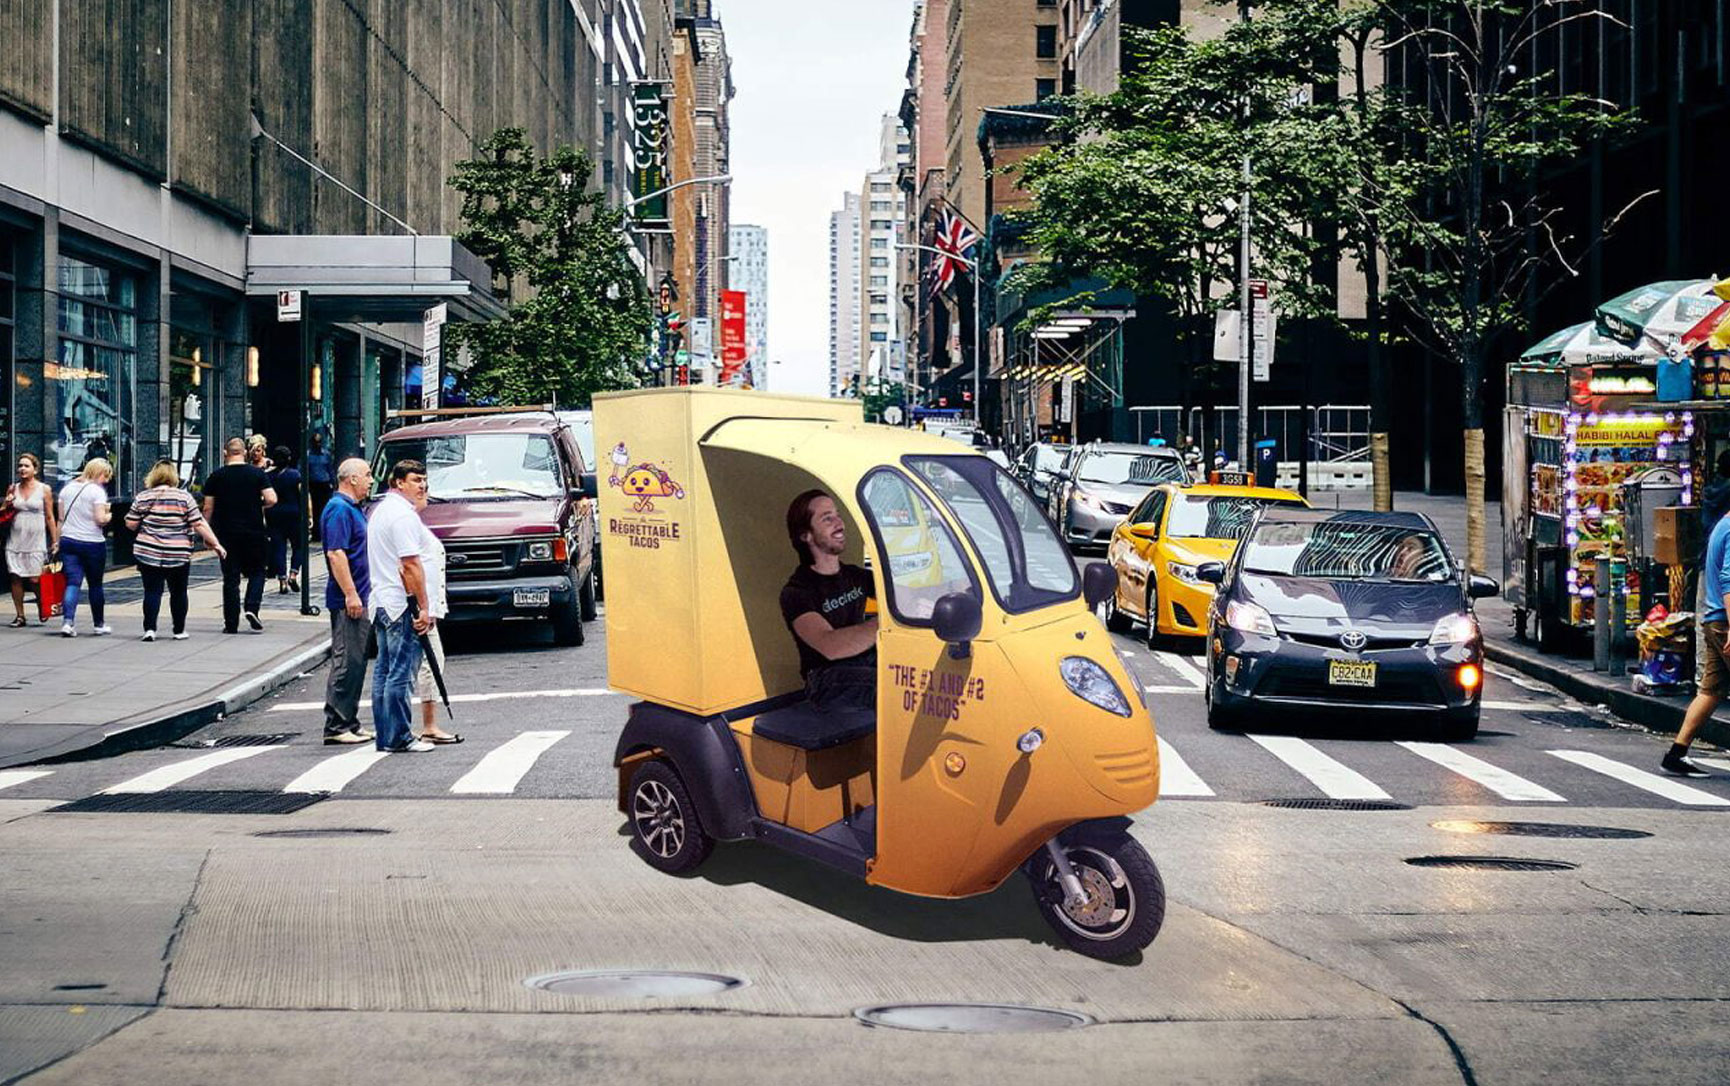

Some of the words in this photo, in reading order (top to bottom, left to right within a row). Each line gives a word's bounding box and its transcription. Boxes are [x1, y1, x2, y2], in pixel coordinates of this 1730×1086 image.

[634, 93, 662, 169] 1325
[1576, 430, 1613, 440] HABIBI
[1616, 430, 1652, 440] HALAL
[1263, 449, 1271, 460] P
[629, 535, 660, 550] TACOS
[920, 669, 935, 691] #1
[938, 672, 964, 697] AND
[967, 676, 984, 701] #2
[903, 690, 918, 712] OF
